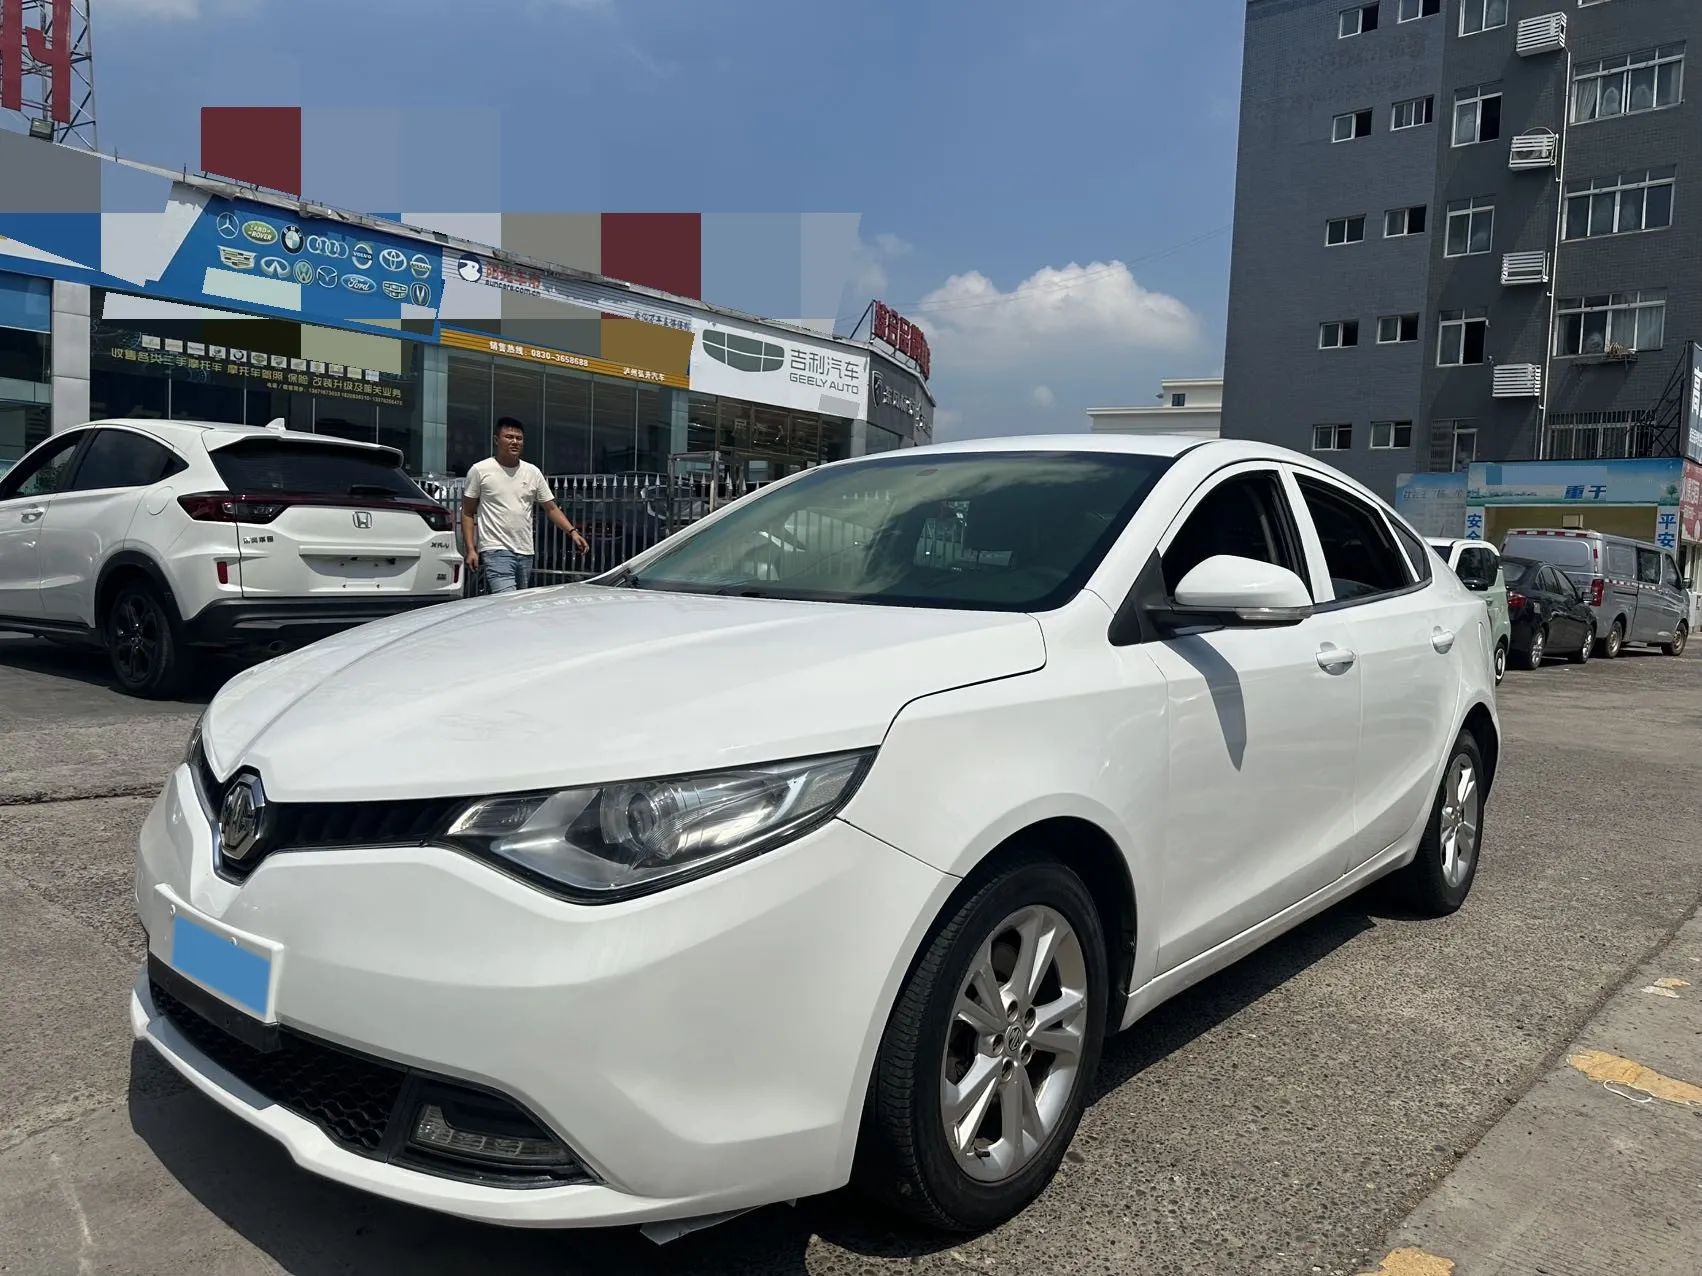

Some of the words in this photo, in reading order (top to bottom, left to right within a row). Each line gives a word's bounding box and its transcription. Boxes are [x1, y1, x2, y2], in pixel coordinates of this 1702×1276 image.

[250, 231, 272, 241] ROVER
[353, 251, 372, 259] VOLVO
[410, 262, 431, 270] NISSAN
[348, 276, 370, 291] Ford
[790, 349, 859, 381] 吉利汽车
[288, 373, 309, 385] 保险
[789, 372, 828, 388] GEELY
[829, 381, 859, 395] AUTO
[1658, 513, 1677, 548] 平安
